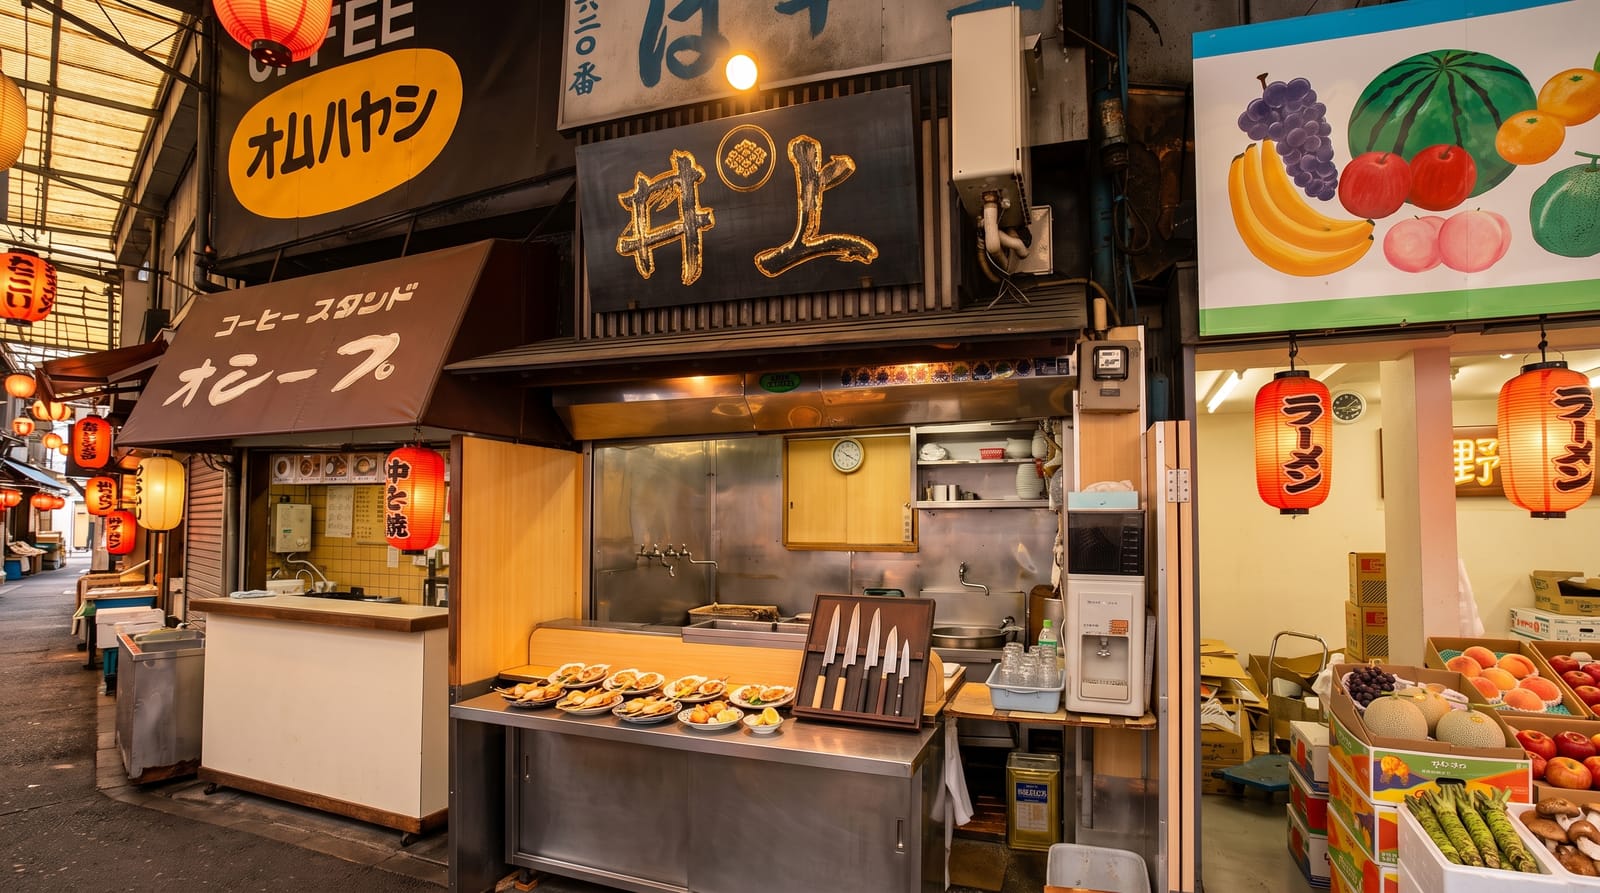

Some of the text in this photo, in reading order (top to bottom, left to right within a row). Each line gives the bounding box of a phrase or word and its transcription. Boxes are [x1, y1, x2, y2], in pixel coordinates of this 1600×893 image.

[246, 84, 437, 180] オムハヤシ
[616, 134, 879, 286] 井上
[214, 282, 419, 338] コーヒー スタンド
[1282, 394, 1324, 494] ラーメン
[1551, 386, 1594, 492] ラーメン
